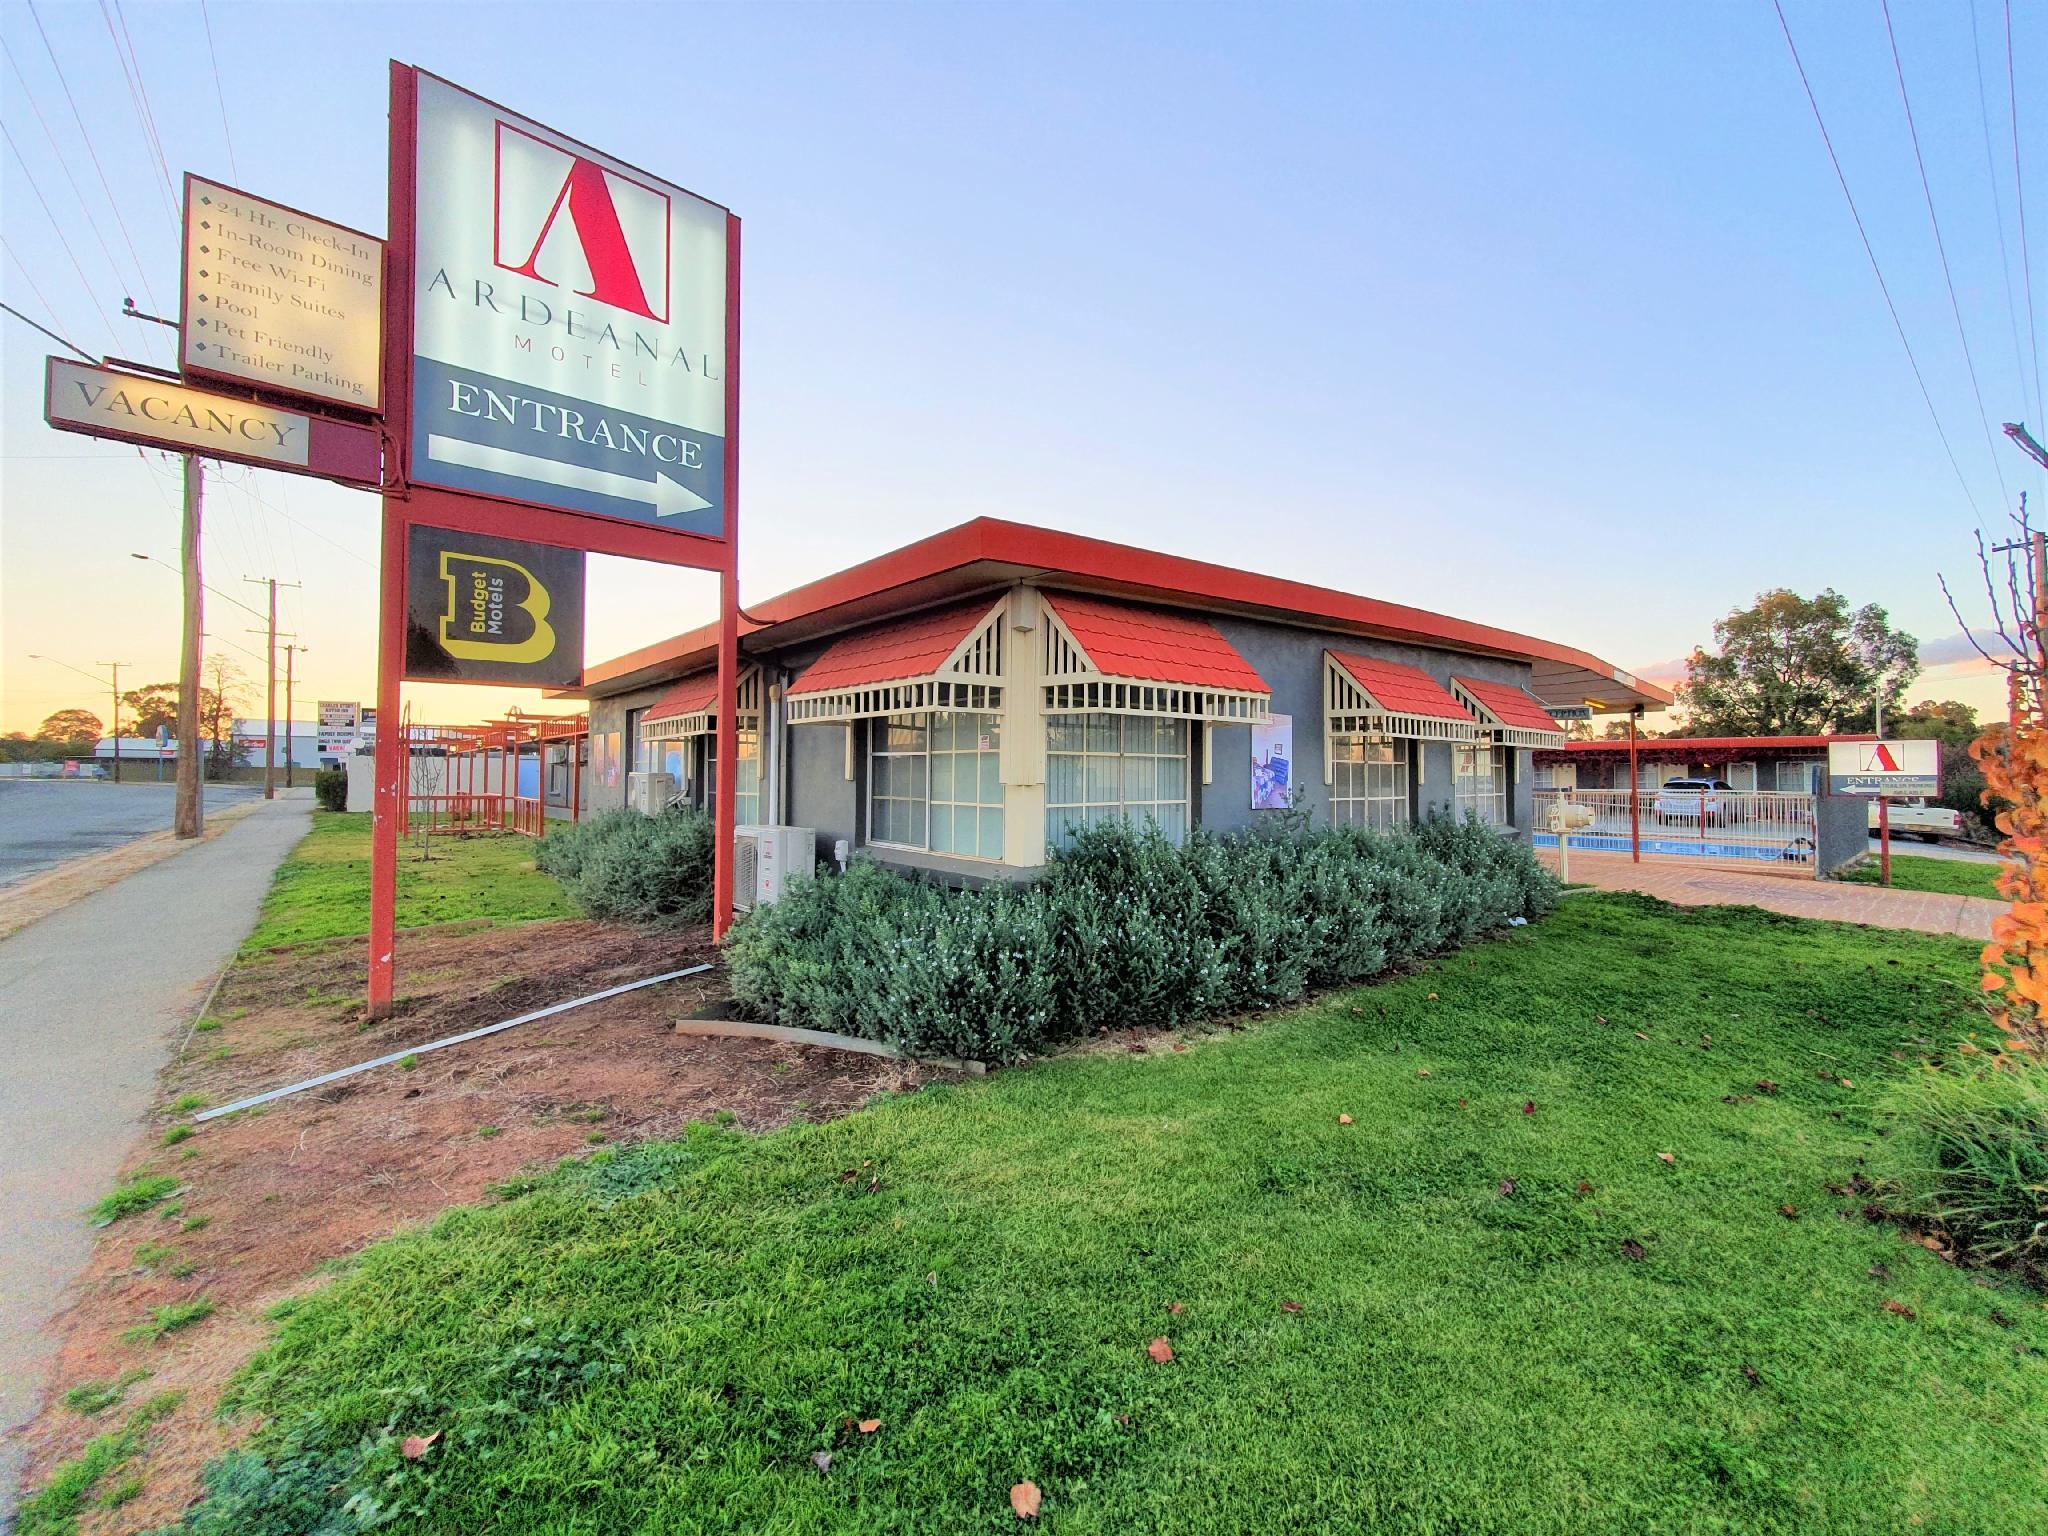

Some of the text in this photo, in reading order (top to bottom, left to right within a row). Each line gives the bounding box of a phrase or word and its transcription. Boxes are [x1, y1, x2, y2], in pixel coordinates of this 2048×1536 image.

[217, 202, 369, 260] 24 Hr. Check-In
[217, 223, 374, 288] In-Room Dining
[216, 271, 345, 320] Family Suites
[217, 247, 326, 292] Free Wi-Fi
[215, 295, 258, 319] Pool
[428, 268, 719, 381] ARDEANAL
[213, 343, 364, 395] Trailer Parking
[214, 319, 333, 365] Pet Friendly
[514, 334, 648, 387] MOTEL
[73, 380, 296, 447] VACANCY
[447, 379, 703, 469] ENTRANCE
[470, 571, 489, 633] Budget
[487, 577, 504, 634] Motels
